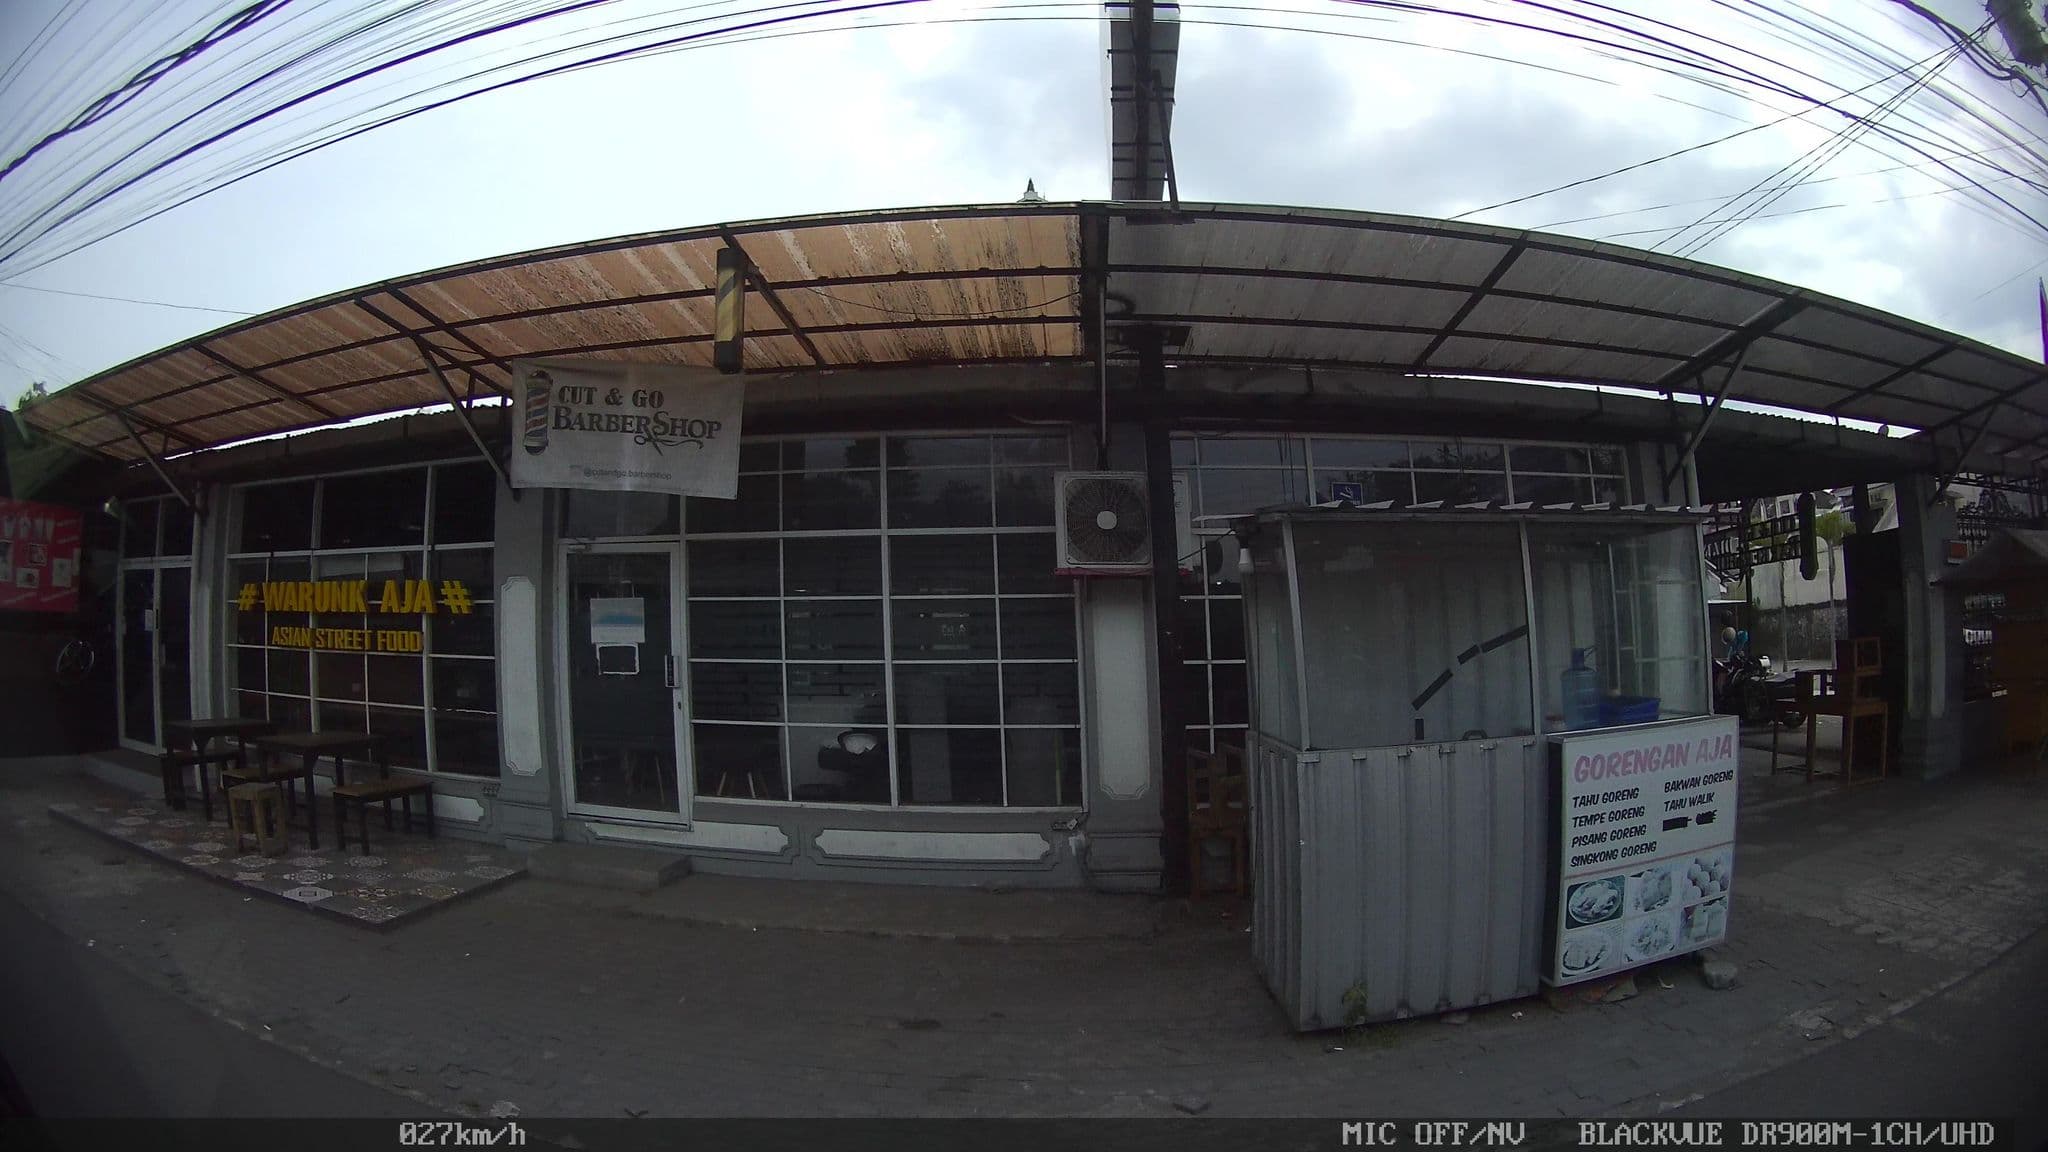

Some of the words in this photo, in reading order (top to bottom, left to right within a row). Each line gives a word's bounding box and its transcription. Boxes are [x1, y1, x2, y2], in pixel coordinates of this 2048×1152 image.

[558, 385, 597, 405] CUT
[604, 387, 624, 406] &
[632, 389, 664, 408] GO
[261, 579, 368, 614] WARUNK
[380, 578, 437, 614] AJA
[271, 625, 312, 648] ASIAN
[314, 627, 373, 651] STREET
[377, 630, 424, 653] FOOD
[1574, 742, 1691, 783] GORENGAN
[1696, 734, 1732, 761] AJA
[1664, 775, 1701, 793] BAKWAN
[1702, 770, 1734, 787] GORENG
[1573, 793, 1601, 808] TAHU
[1602, 787, 1640, 804] GORENG
[1664, 797, 1688, 812] TAHU
[1688, 792, 1715, 808] WALIK
[1572, 813, 1607, 829] TEMPE
[1608, 806, 1645, 825] GORENG
[1571, 831, 1608, 848] PISANG
[1609, 825, 1647, 843] GORENG
[1570, 849, 1619, 868] SINGKONG
[1620, 841, 1657, 860] GORENG
